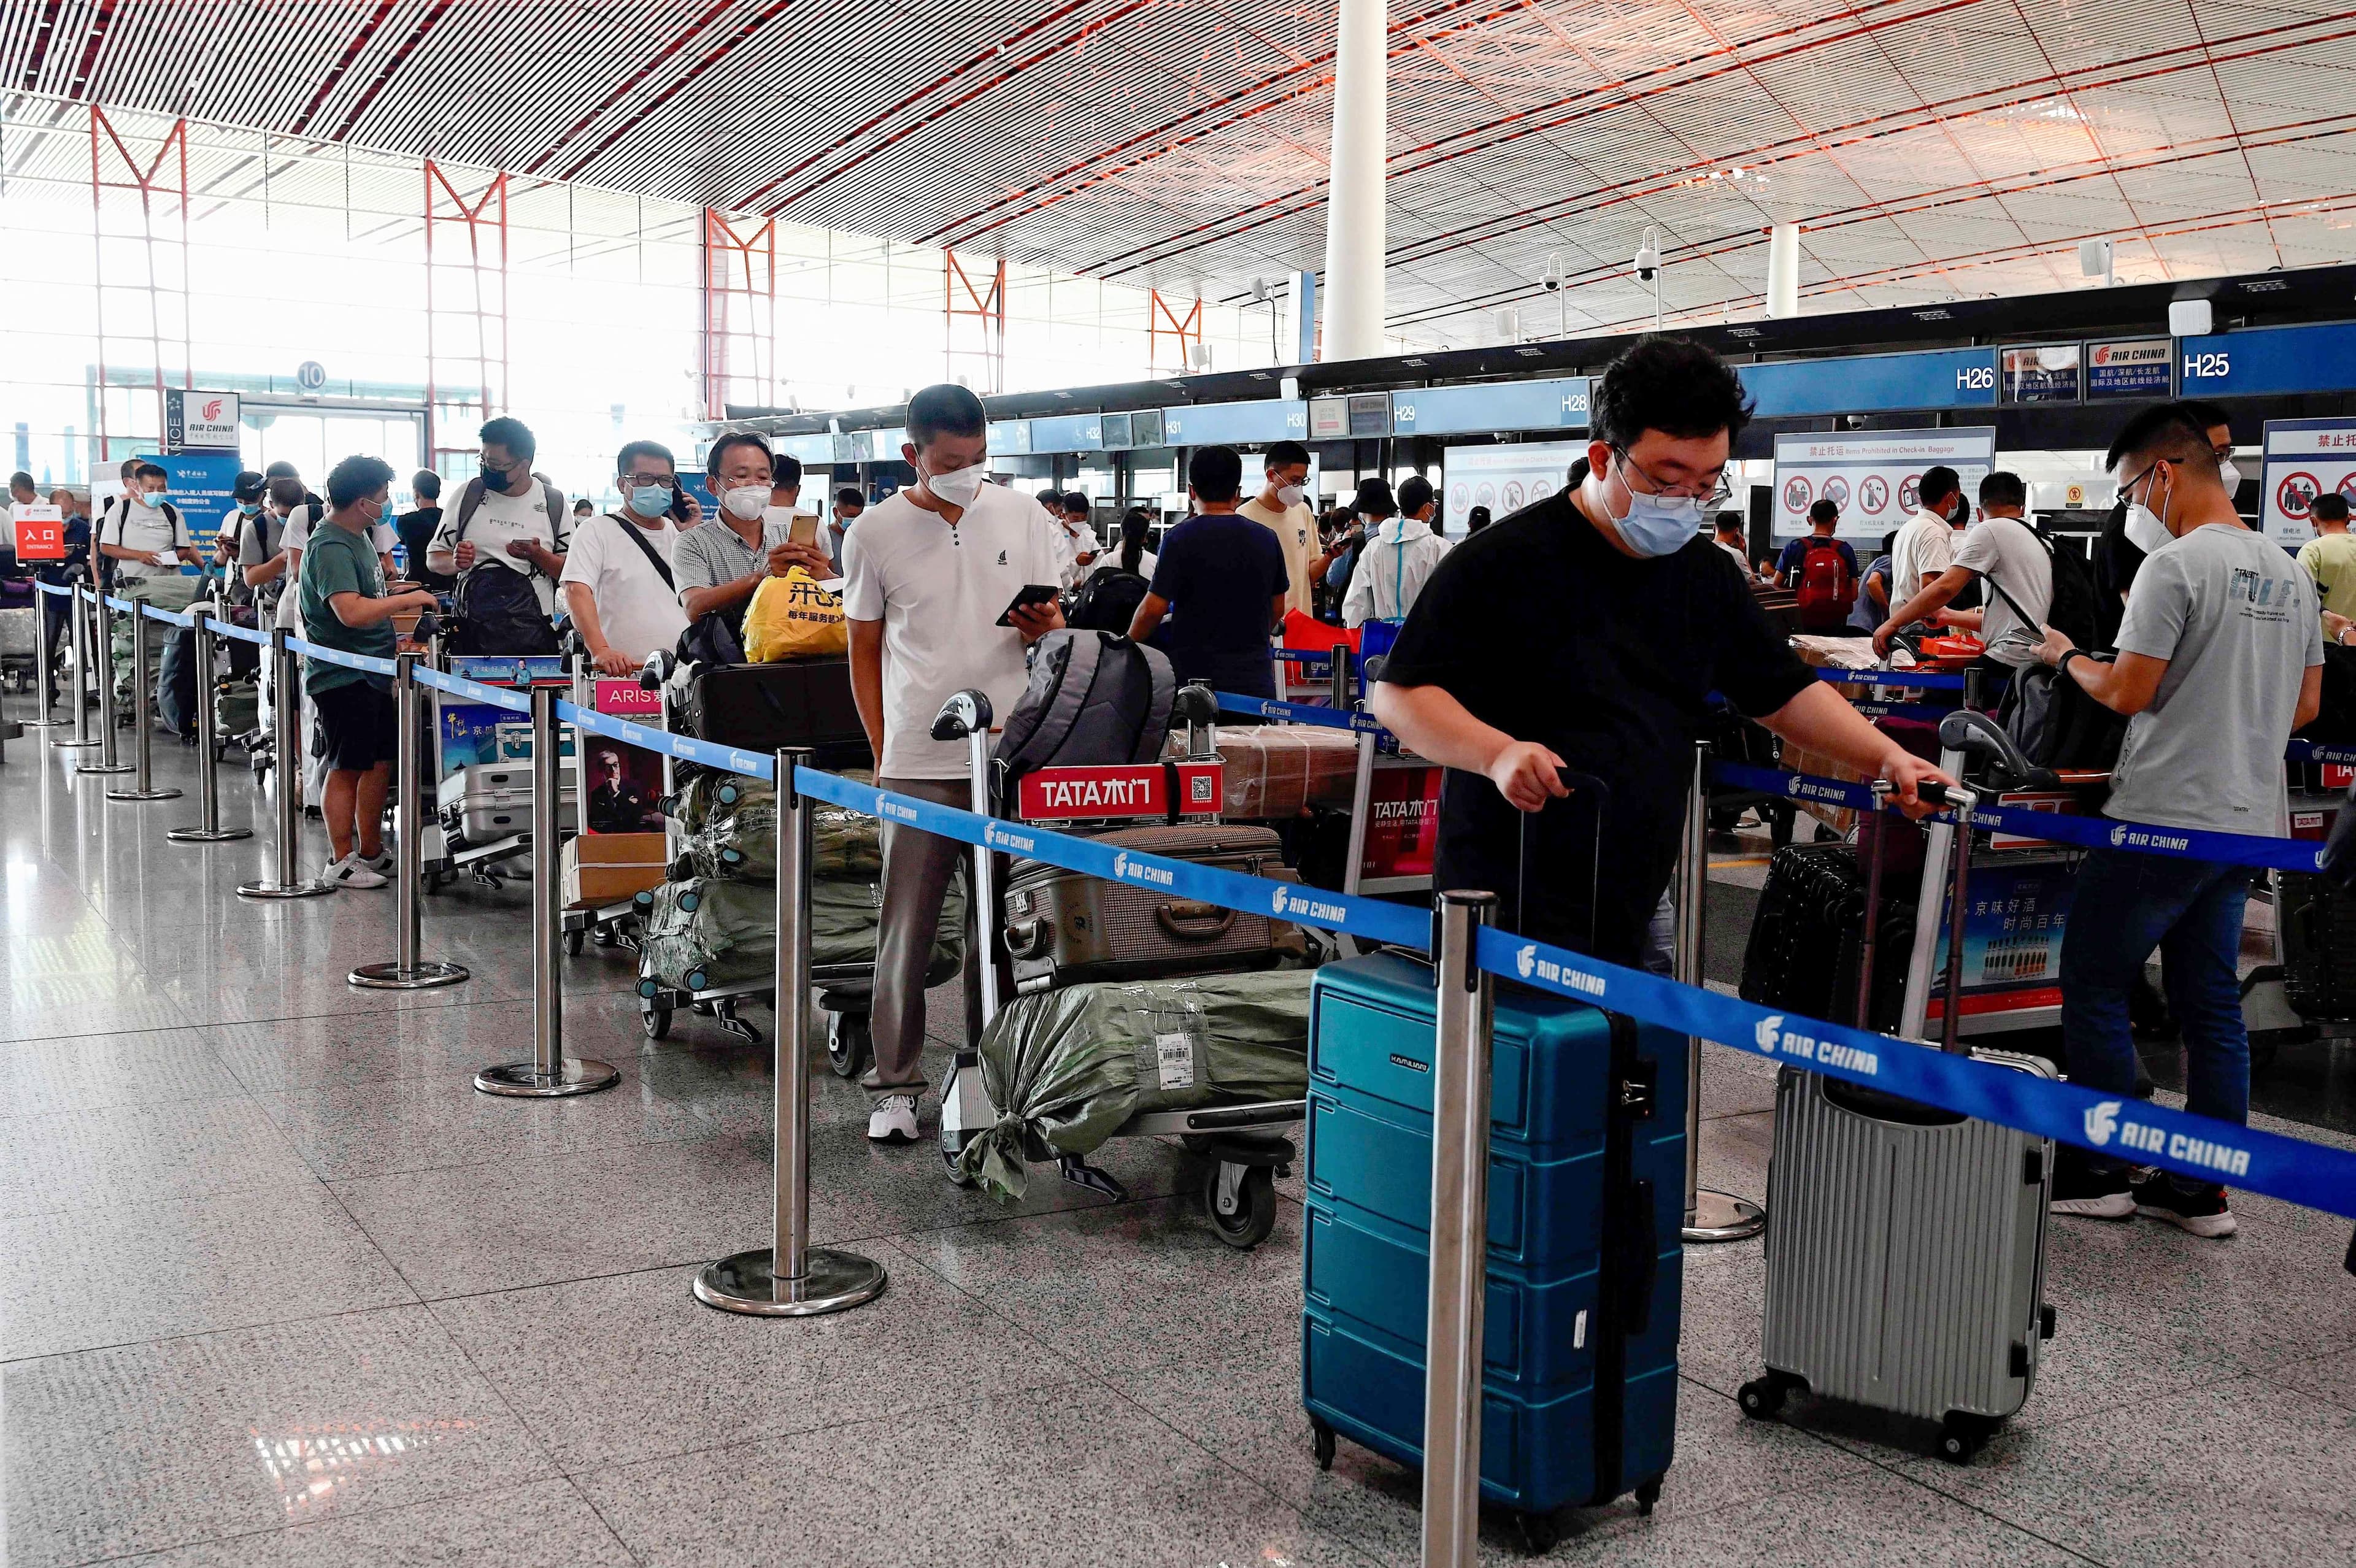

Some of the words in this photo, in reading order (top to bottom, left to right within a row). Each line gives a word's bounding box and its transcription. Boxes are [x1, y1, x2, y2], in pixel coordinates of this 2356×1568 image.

[2111, 351, 2130, 361] AIR
[2132, 348, 2166, 360] CHINA
[2184, 353, 2230, 377] H25
[301, 367, 324, 385] 10
[1957, 367, 1993, 390] H26
[2090, 375, 2169, 387] 国际及地区航线经济舱
[1561, 394, 1587, 412] H28
[1287, 413, 1305, 428] H30
[1394, 405, 1415, 422] H29
[170, 417, 181, 456] NCE
[1086, 427, 1100, 439] H32
[1166, 420, 1181, 434] H31
[1809, 446, 1844, 456] 禁止托运
[25, 529, 55, 540] 入口
[1357, 719, 1366, 728] AIR
[2326, 751, 2341, 761] AIR
[1040, 778, 1150, 807] TATA木门
[1801, 783, 1817, 796] AIR
[1818, 786, 1846, 801] CHINA
[885, 802, 896, 815] AIR
[897, 805, 918, 822] CHINA
[1374, 799, 1439, 819] TATA木门
[1971, 812, 2002, 826] CHINA
[996, 831, 1009, 845] AIR
[1011, 834, 1034, 851] CHINA
[2128, 832, 2149, 846] AIR
[2151, 835, 2189, 851] CHINA
[1128, 863, 1142, 880] AIR
[1144, 866, 1173, 886] CHINA
[1289, 897, 1309, 915] AIR
[1310, 901, 1345, 923] CHINA
[1974, 897, 2036, 917] 京味好酒
[2003, 912, 2066, 932] 时尚百年
[1537, 959, 1560, 982] AIR
[1561, 967, 1606, 997] CHINA
[1782, 1032, 1815, 1059] AIR
[1817, 1041, 1878, 1076] CHINA
[2120, 1121, 2166, 1155] AIR
[2168, 1133, 2251, 1178] CHINA
